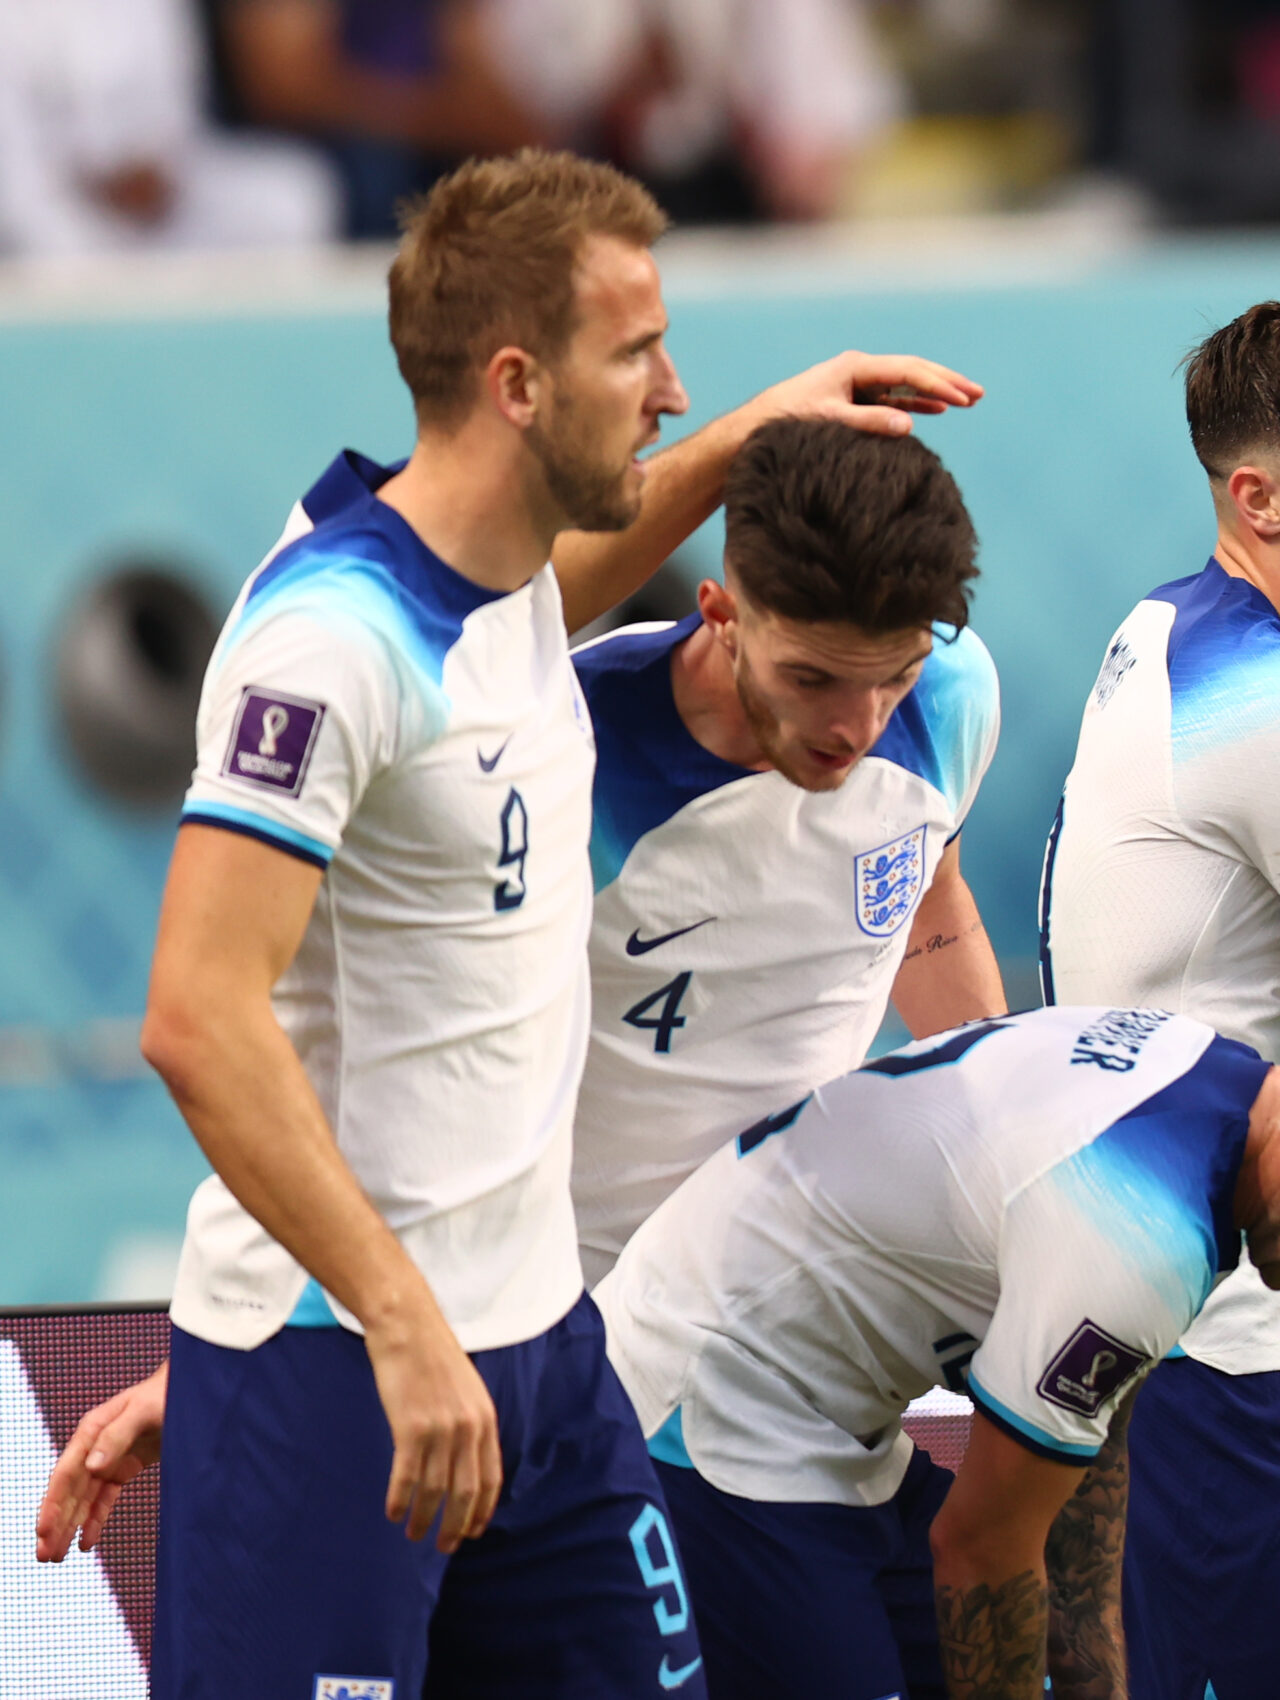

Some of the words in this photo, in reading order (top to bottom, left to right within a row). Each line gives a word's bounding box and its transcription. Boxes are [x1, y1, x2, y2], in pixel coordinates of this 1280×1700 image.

[494, 784, 529, 912] 9
[621, 969, 693, 1054] 4
[628, 1502, 689, 1637] 9
